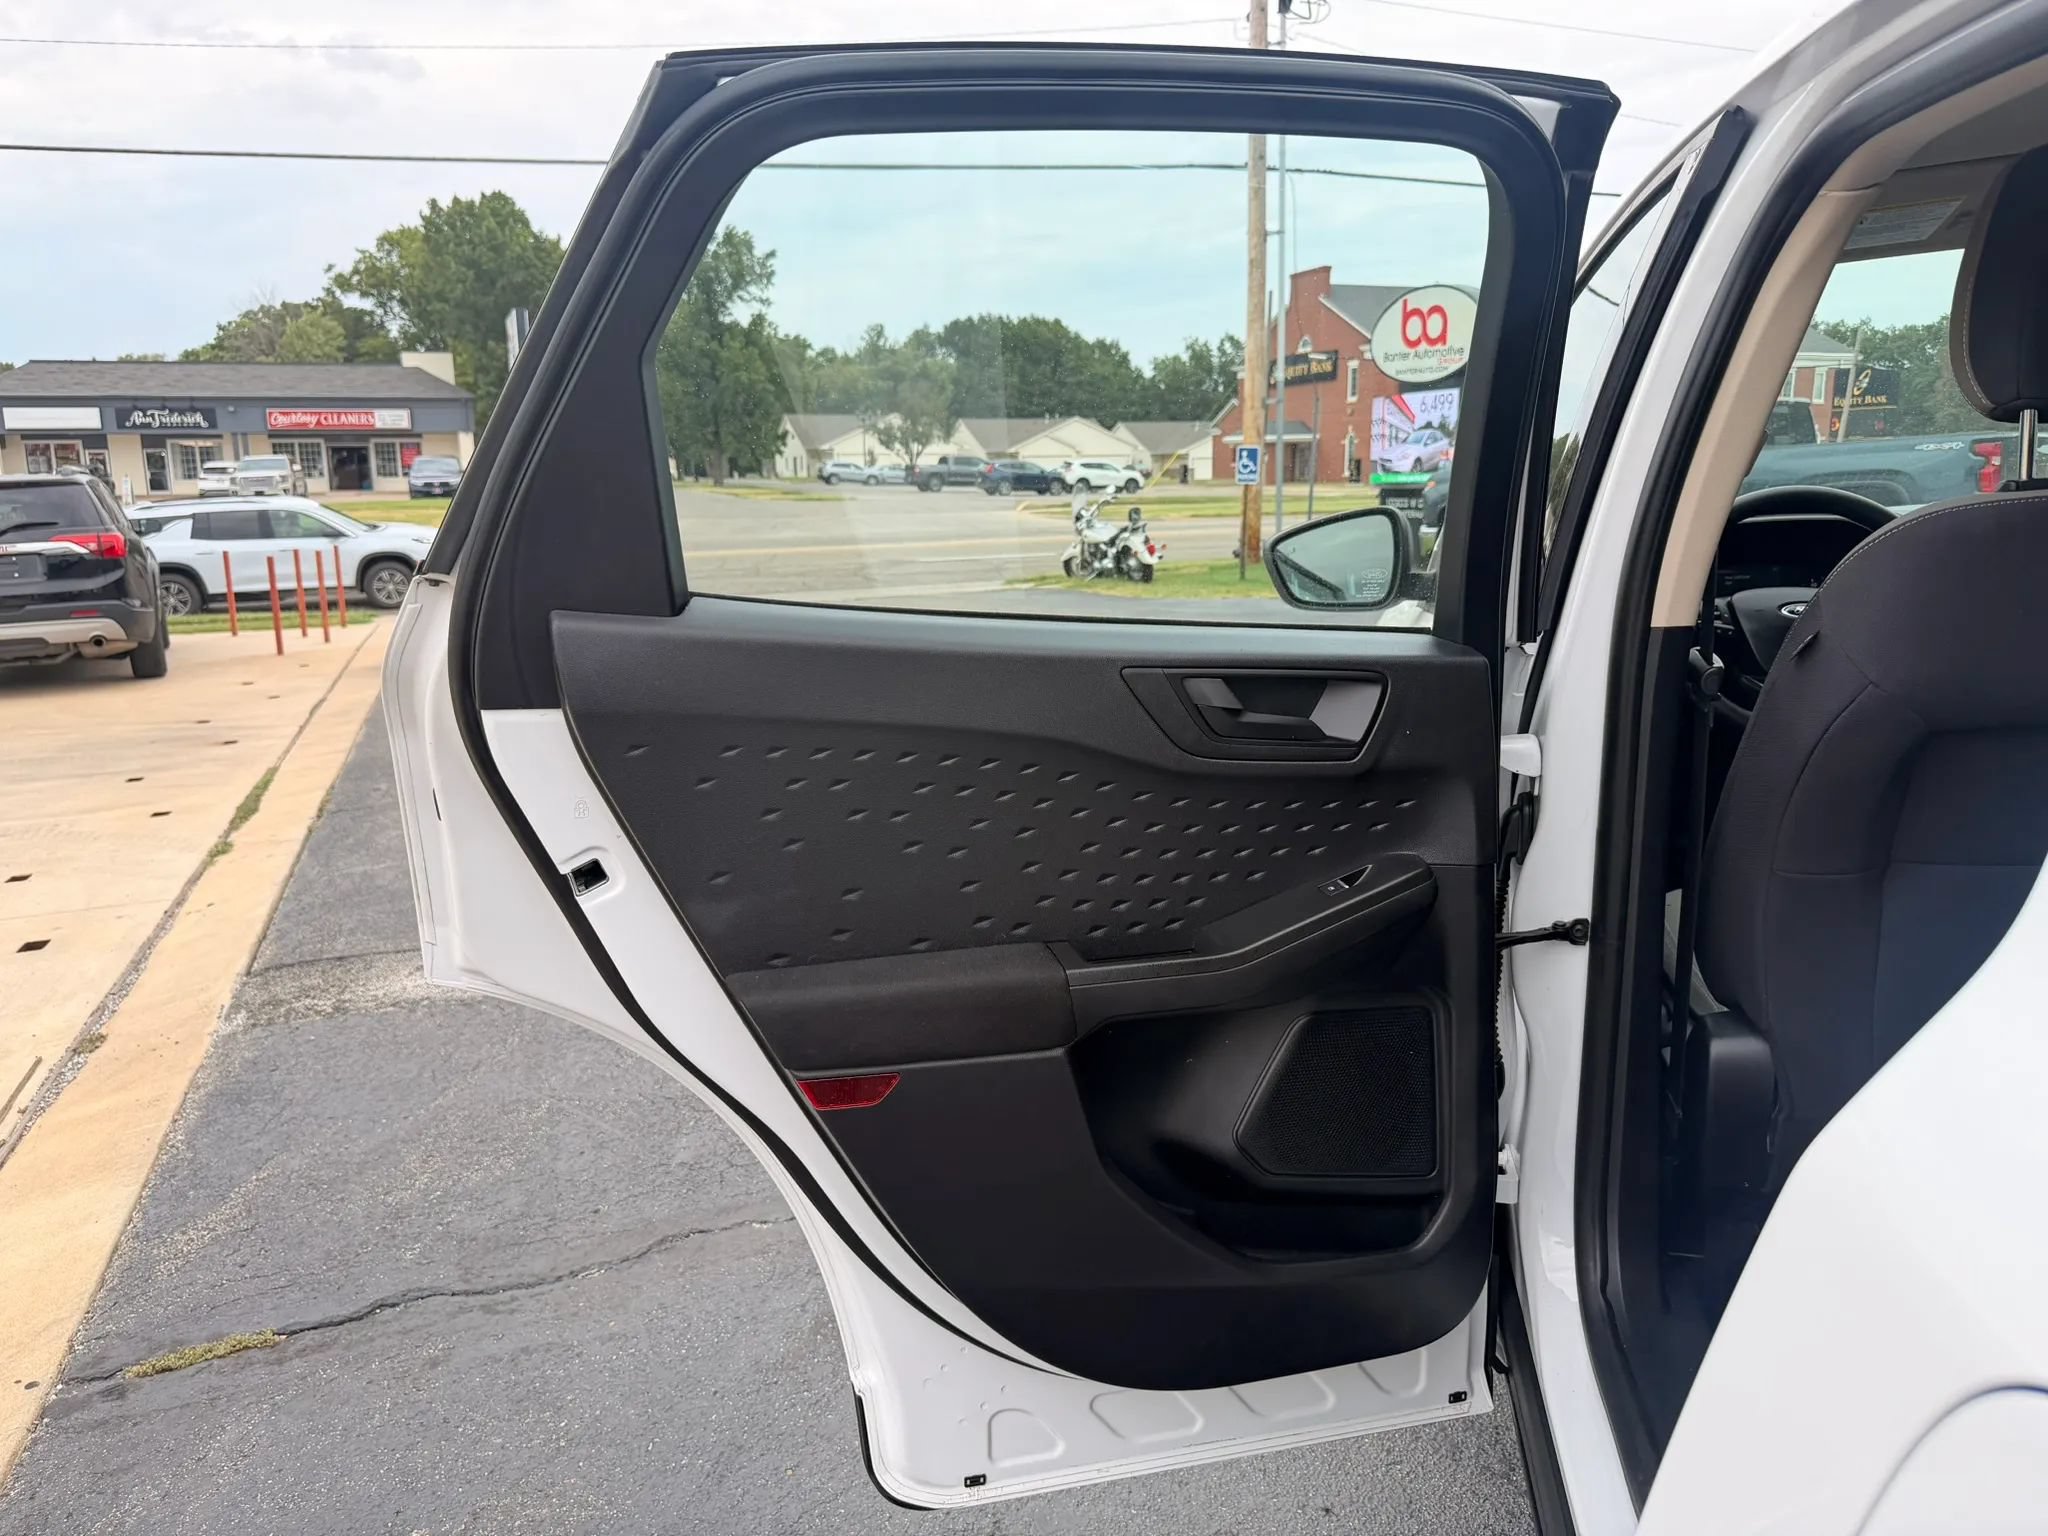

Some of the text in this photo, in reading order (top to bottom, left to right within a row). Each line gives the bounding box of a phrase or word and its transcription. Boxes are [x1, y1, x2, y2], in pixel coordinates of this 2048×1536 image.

[1412, 345, 1464, 360] Automotive
[1283, 364, 1308, 380] QUITY
[1420, 393, 1454, 413] 6,499
[1834, 395, 1888, 407] EQITY BANK
[319, 412, 375, 425] CLEANERS
